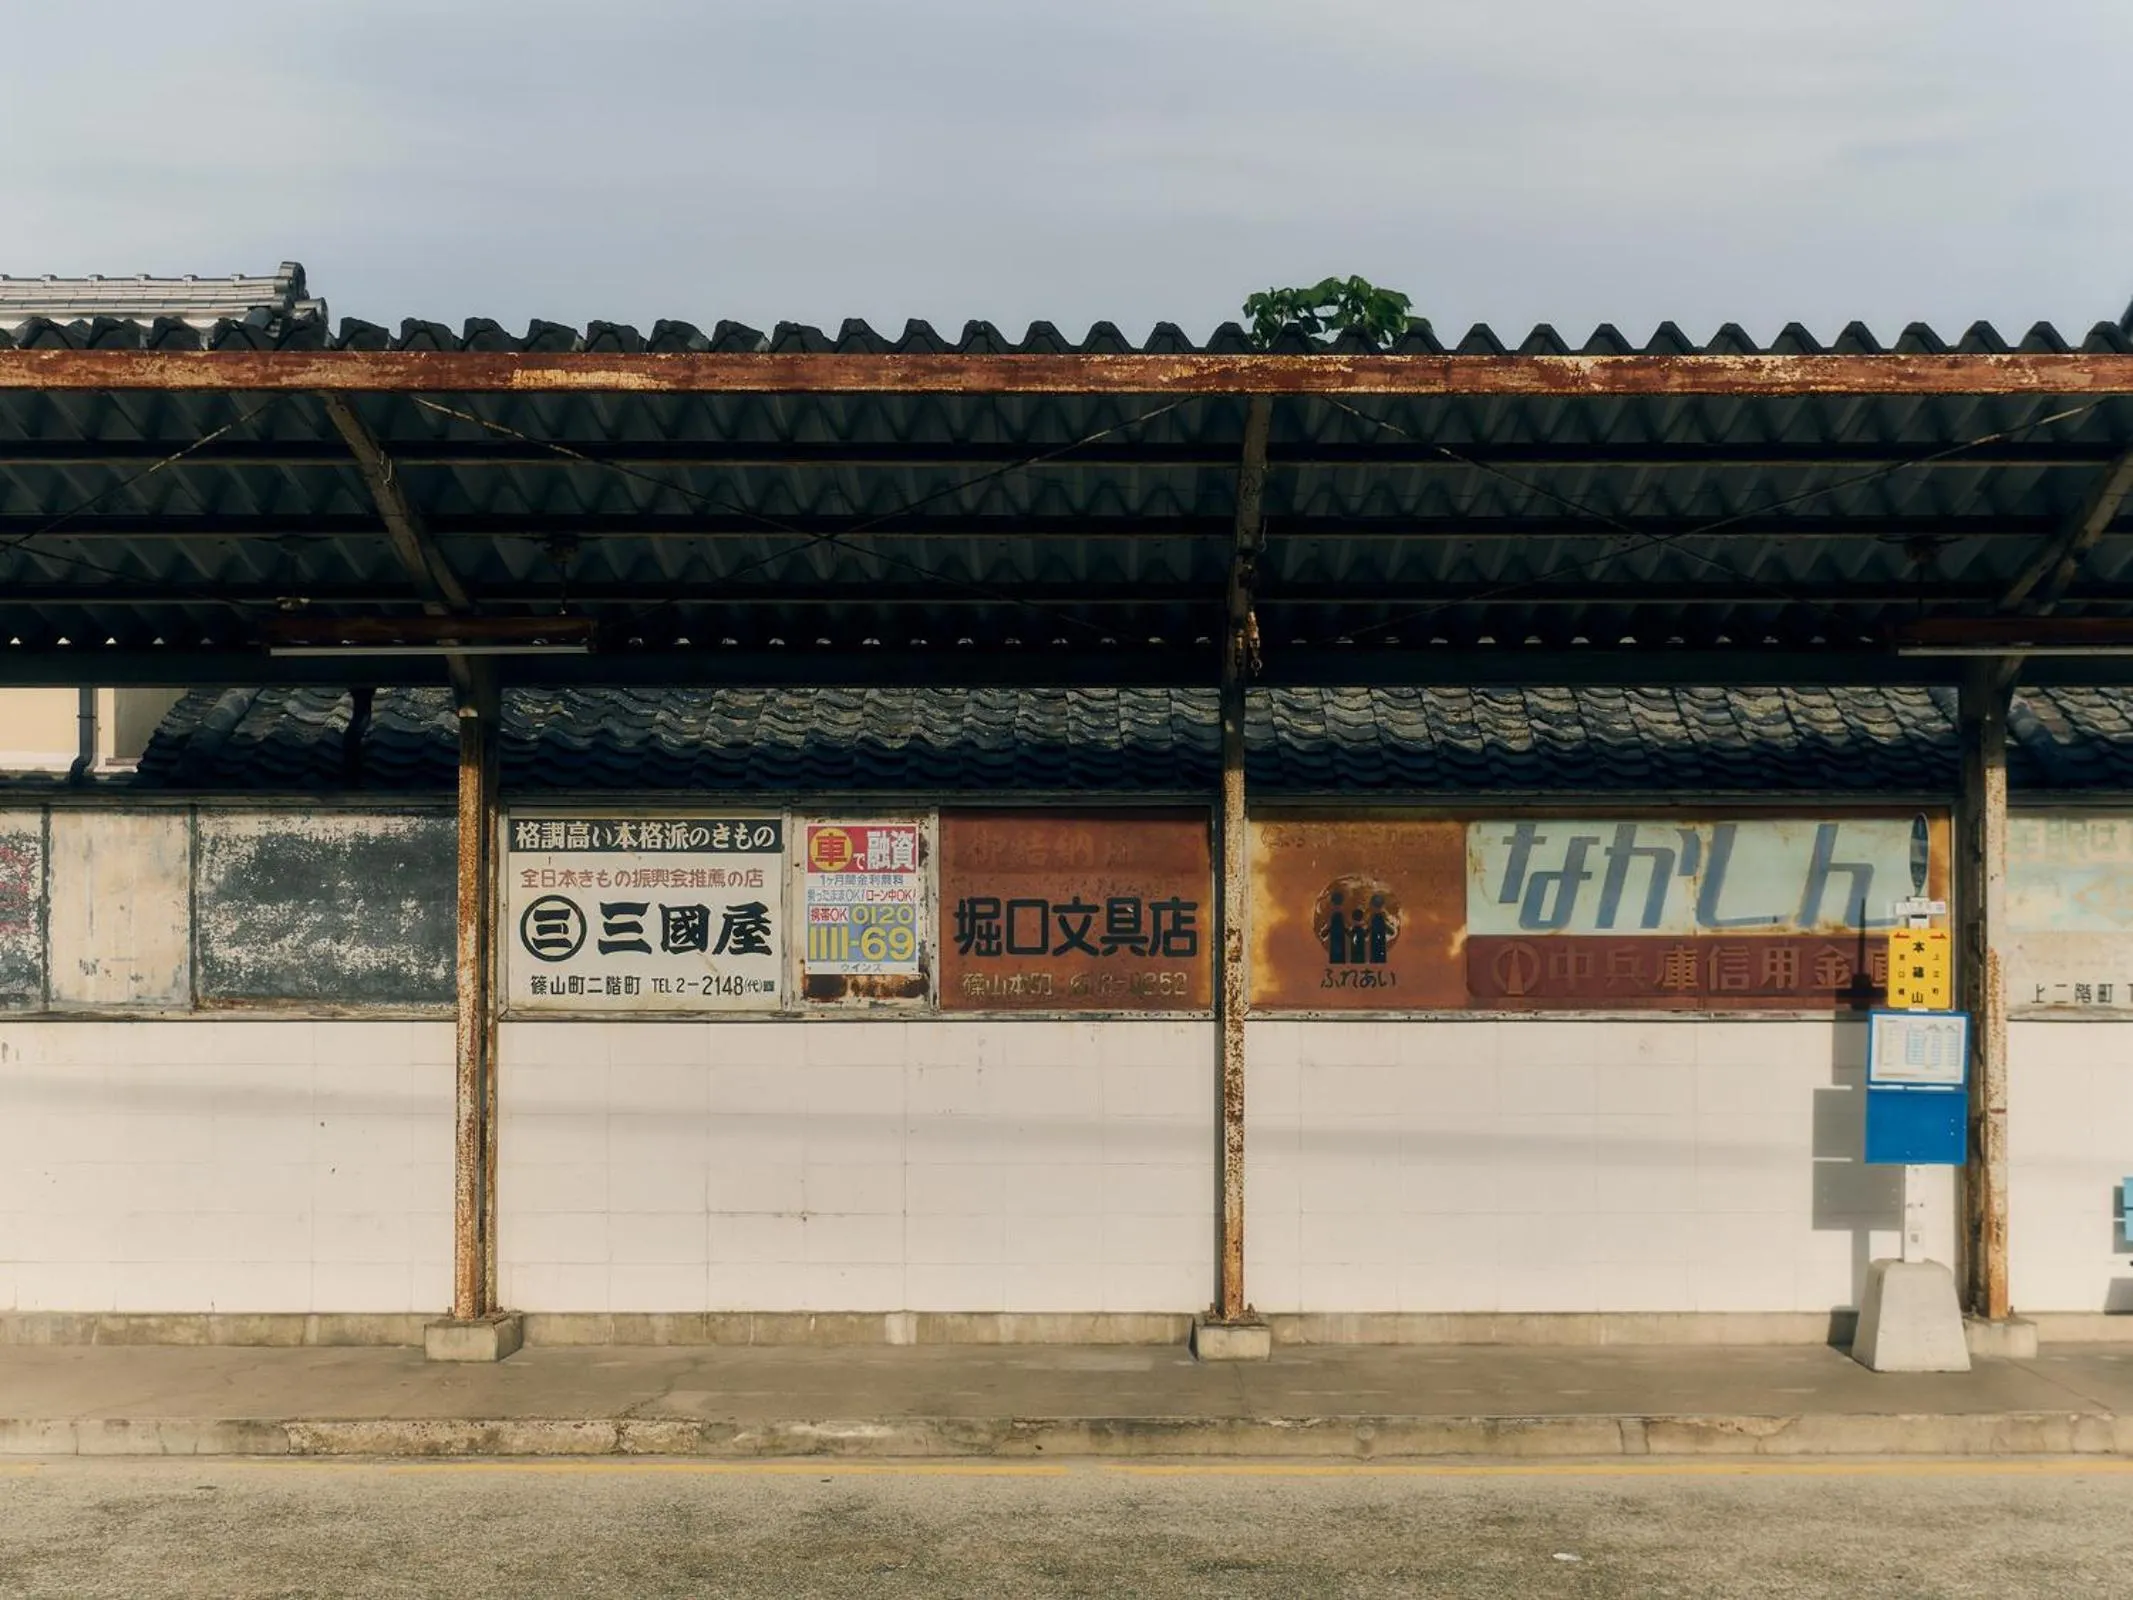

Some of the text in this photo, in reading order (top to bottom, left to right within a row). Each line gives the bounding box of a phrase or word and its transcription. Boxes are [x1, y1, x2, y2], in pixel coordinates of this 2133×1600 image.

[516, 821, 775, 849] 格調高い本格派のきもの
[814, 830, 915, 870] 車で融資
[1498, 823, 1899, 930] なかしん
[598, 901, 773, 955] 三國屋
[852, 904, 915, 925] 0120
[953, 896, 1198, 958] 堀口文具店
[1319, 967, 1397, 989] ふれあい
